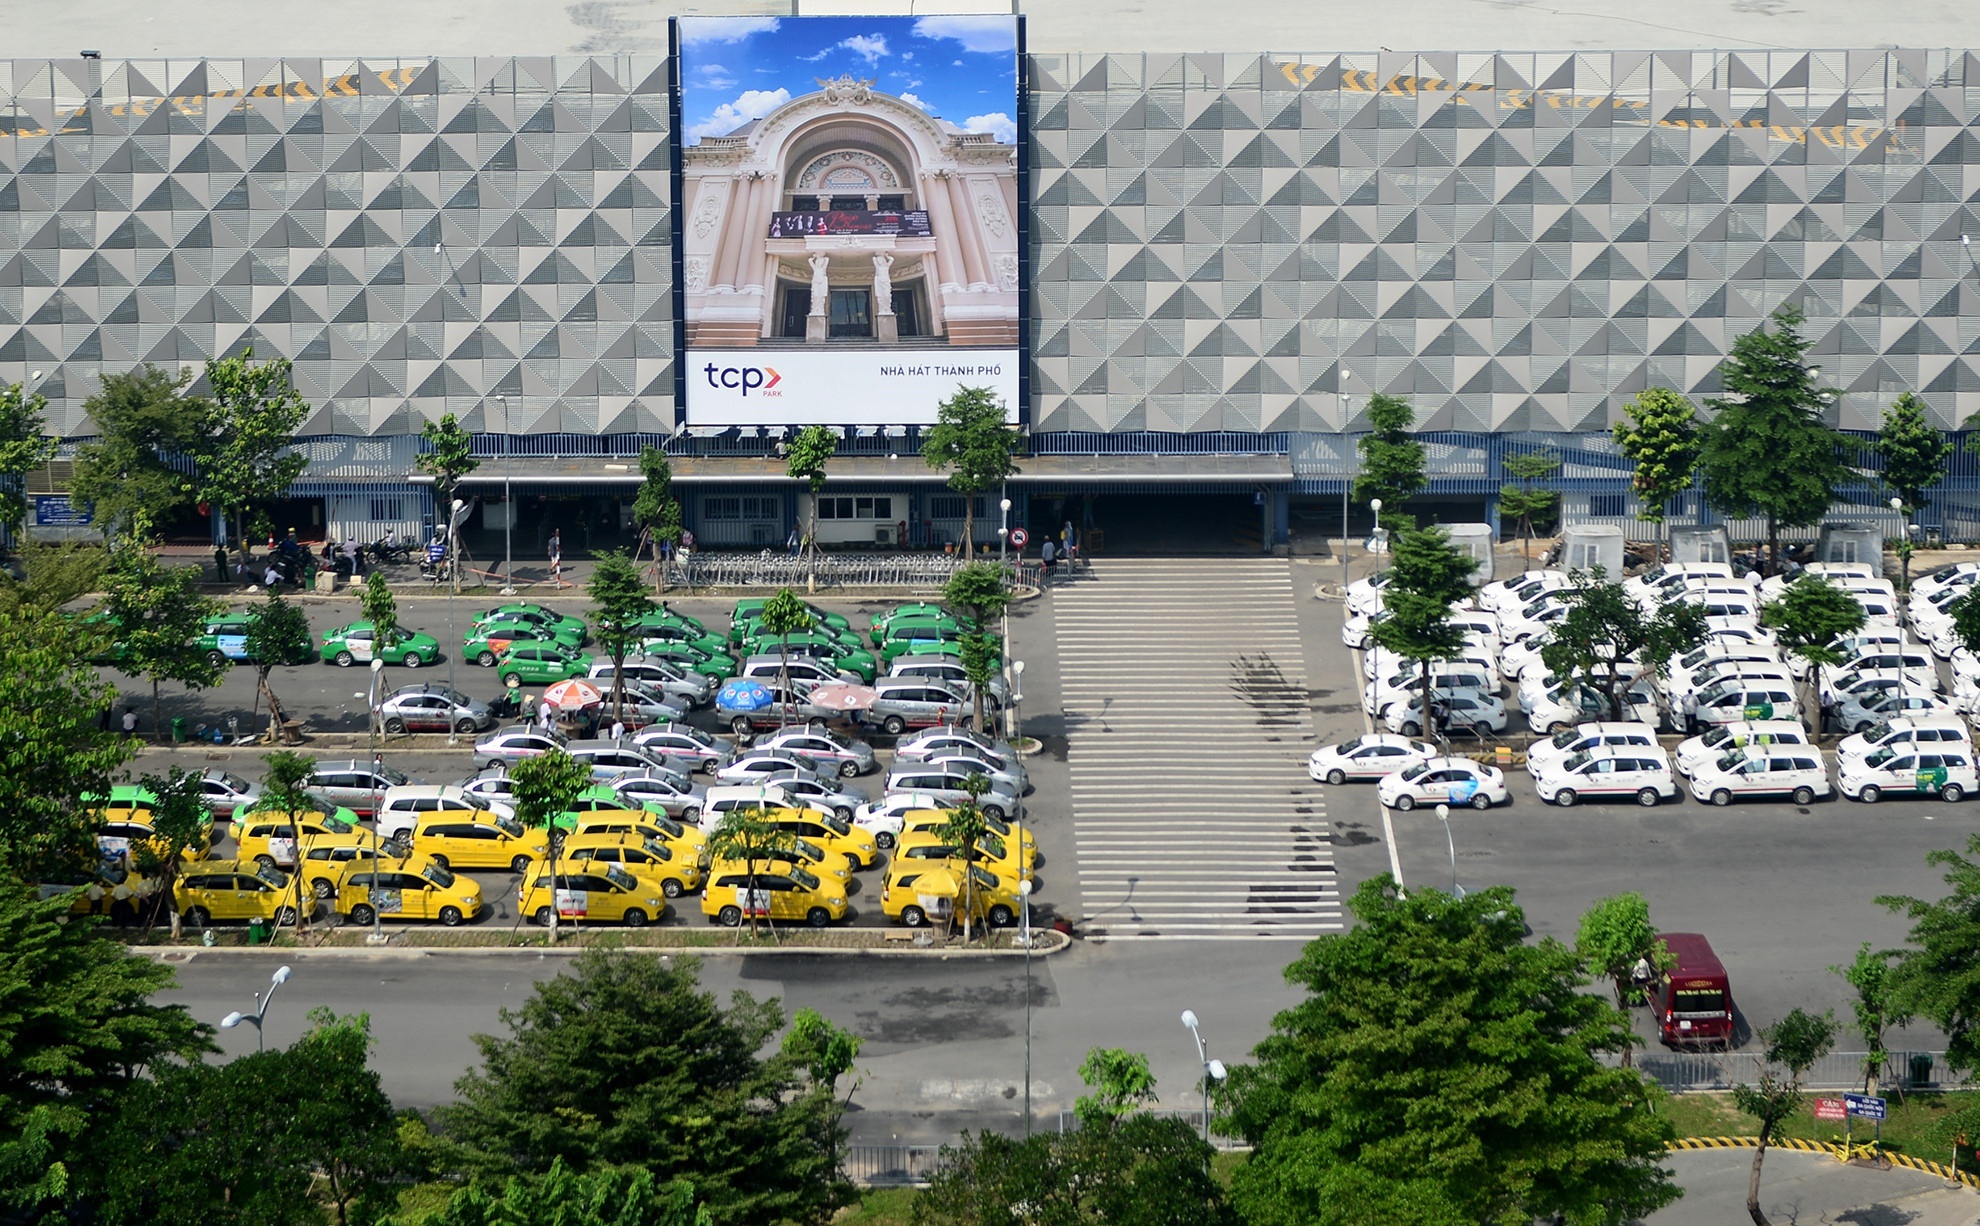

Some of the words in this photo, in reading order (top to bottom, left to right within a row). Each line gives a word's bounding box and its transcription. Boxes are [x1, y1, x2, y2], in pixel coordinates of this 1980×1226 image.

[880, 363, 905, 376] NHÀ
[908, 363, 931, 376] HÁT
[934, 363, 974, 376] THÀNH
[978, 362, 1002, 376] PHỐ
[704, 362, 763, 396] tcp
[762, 390, 783, 398] PARK
